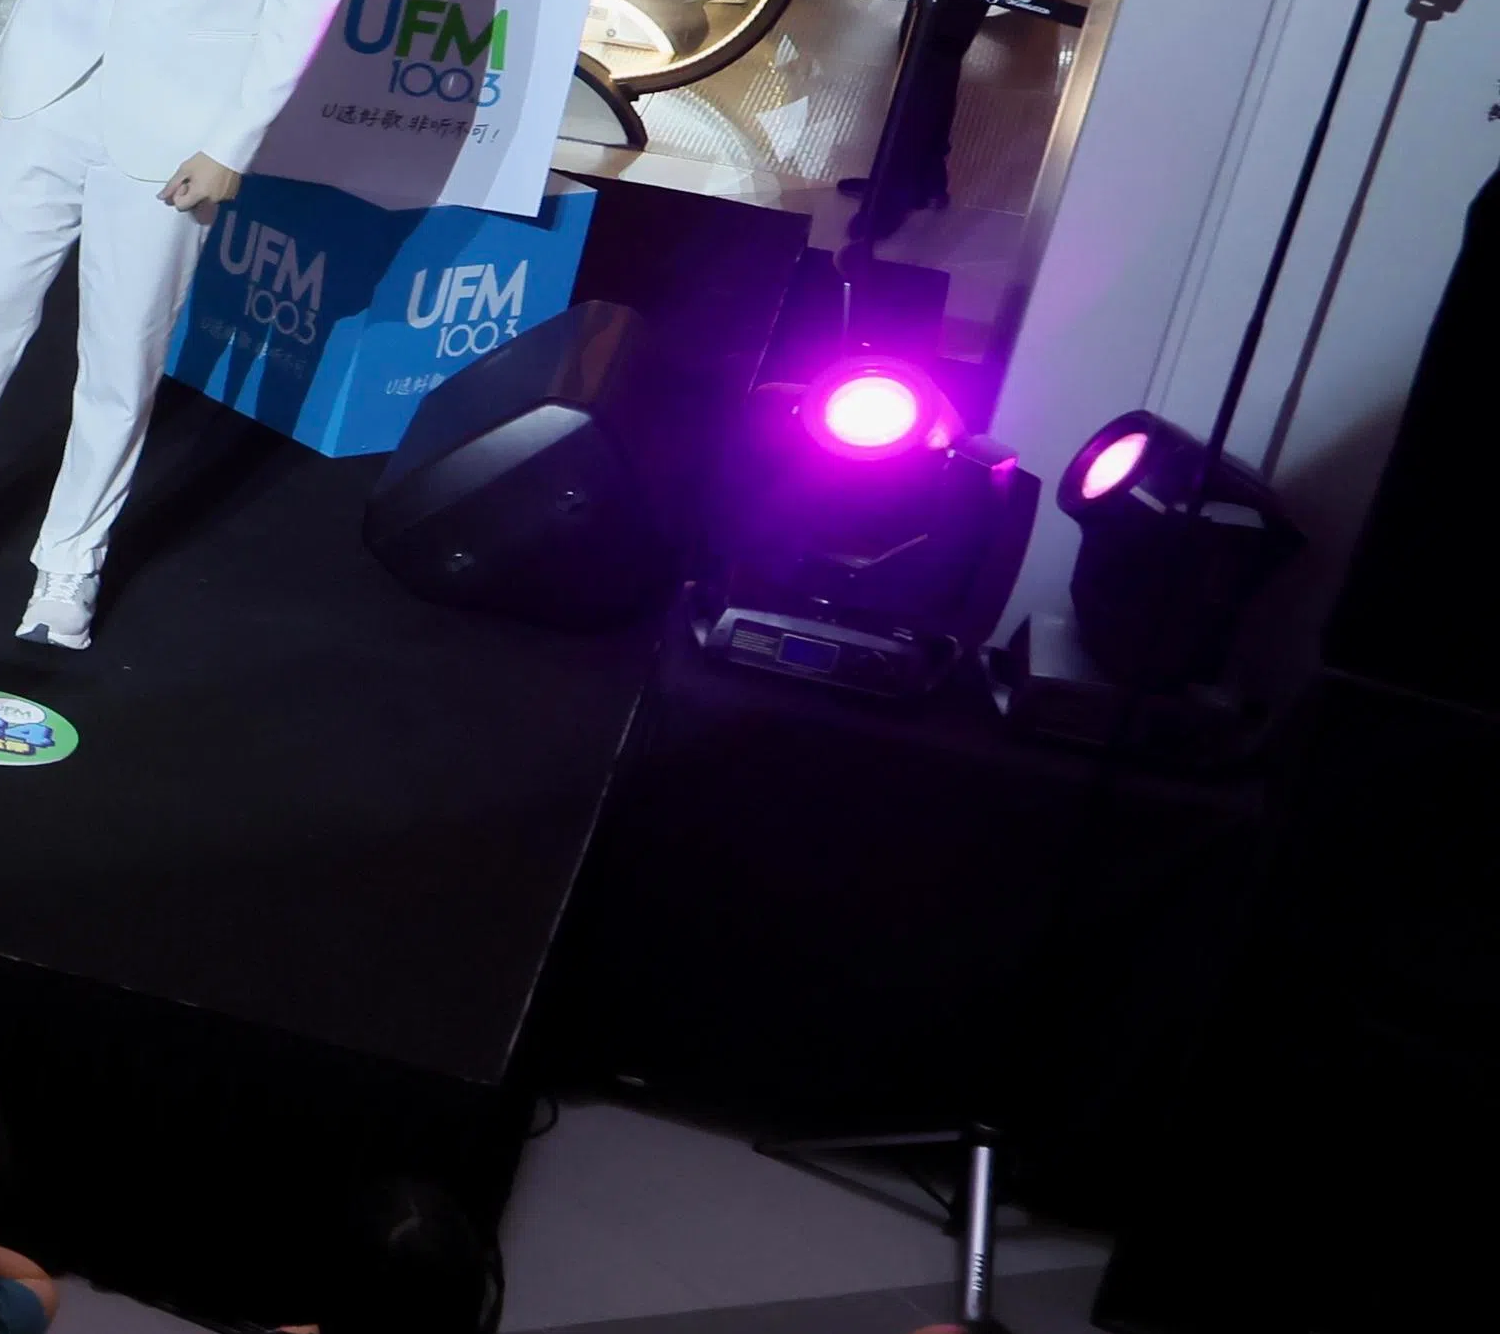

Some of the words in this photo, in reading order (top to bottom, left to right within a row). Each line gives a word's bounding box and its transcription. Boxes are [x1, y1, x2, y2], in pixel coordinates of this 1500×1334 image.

[388, 59, 501, 108] 100.3
[220, 210, 327, 313] UFM
[407, 259, 529, 329] UFM
